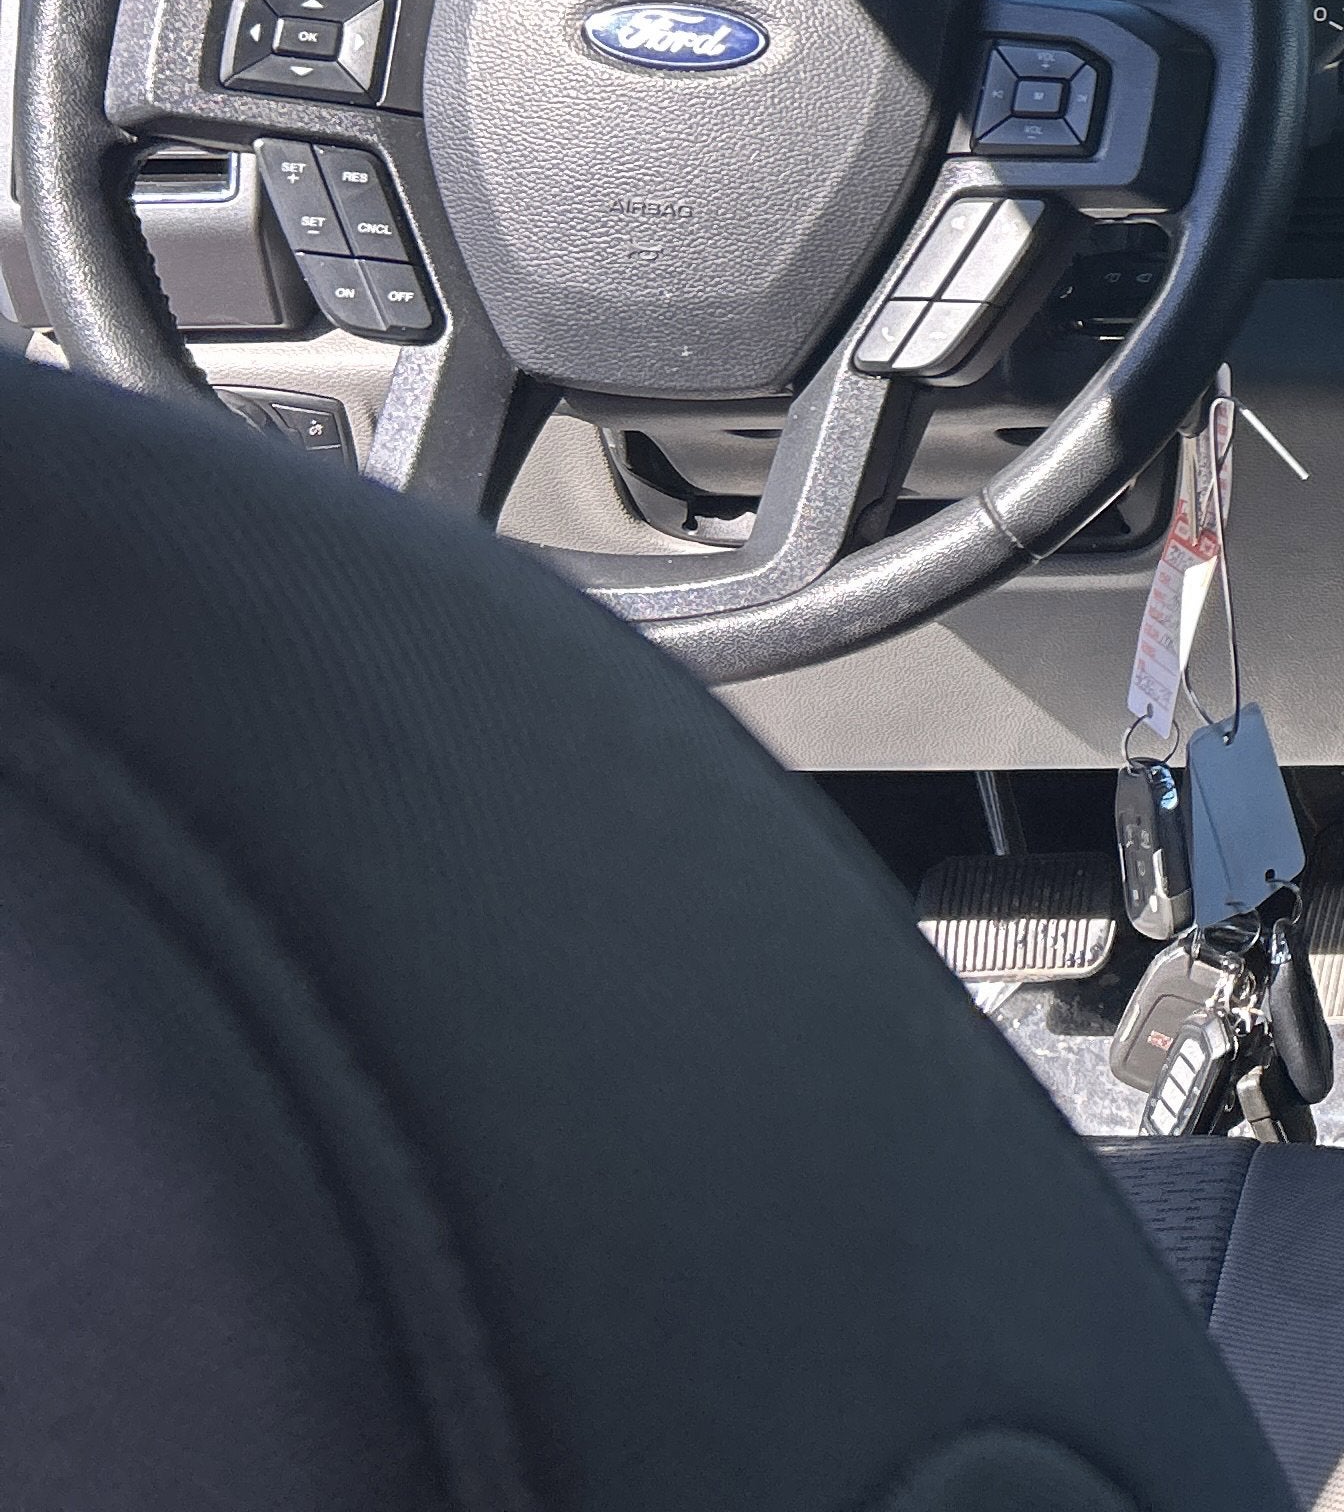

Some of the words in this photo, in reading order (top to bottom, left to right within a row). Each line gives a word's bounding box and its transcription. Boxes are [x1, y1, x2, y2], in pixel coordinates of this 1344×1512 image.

[298, 31, 317, 42] OK
[617, 9, 732, 56] Ford
[281, 162, 306, 173] SET
[342, 171, 369, 184] RES
[609, 198, 693, 218] AIRBAG
[301, 216, 325, 227] SET
[357, 222, 392, 235] CNCL
[335, 287, 355, 299] ON
[387, 290, 415, 302] OFF
